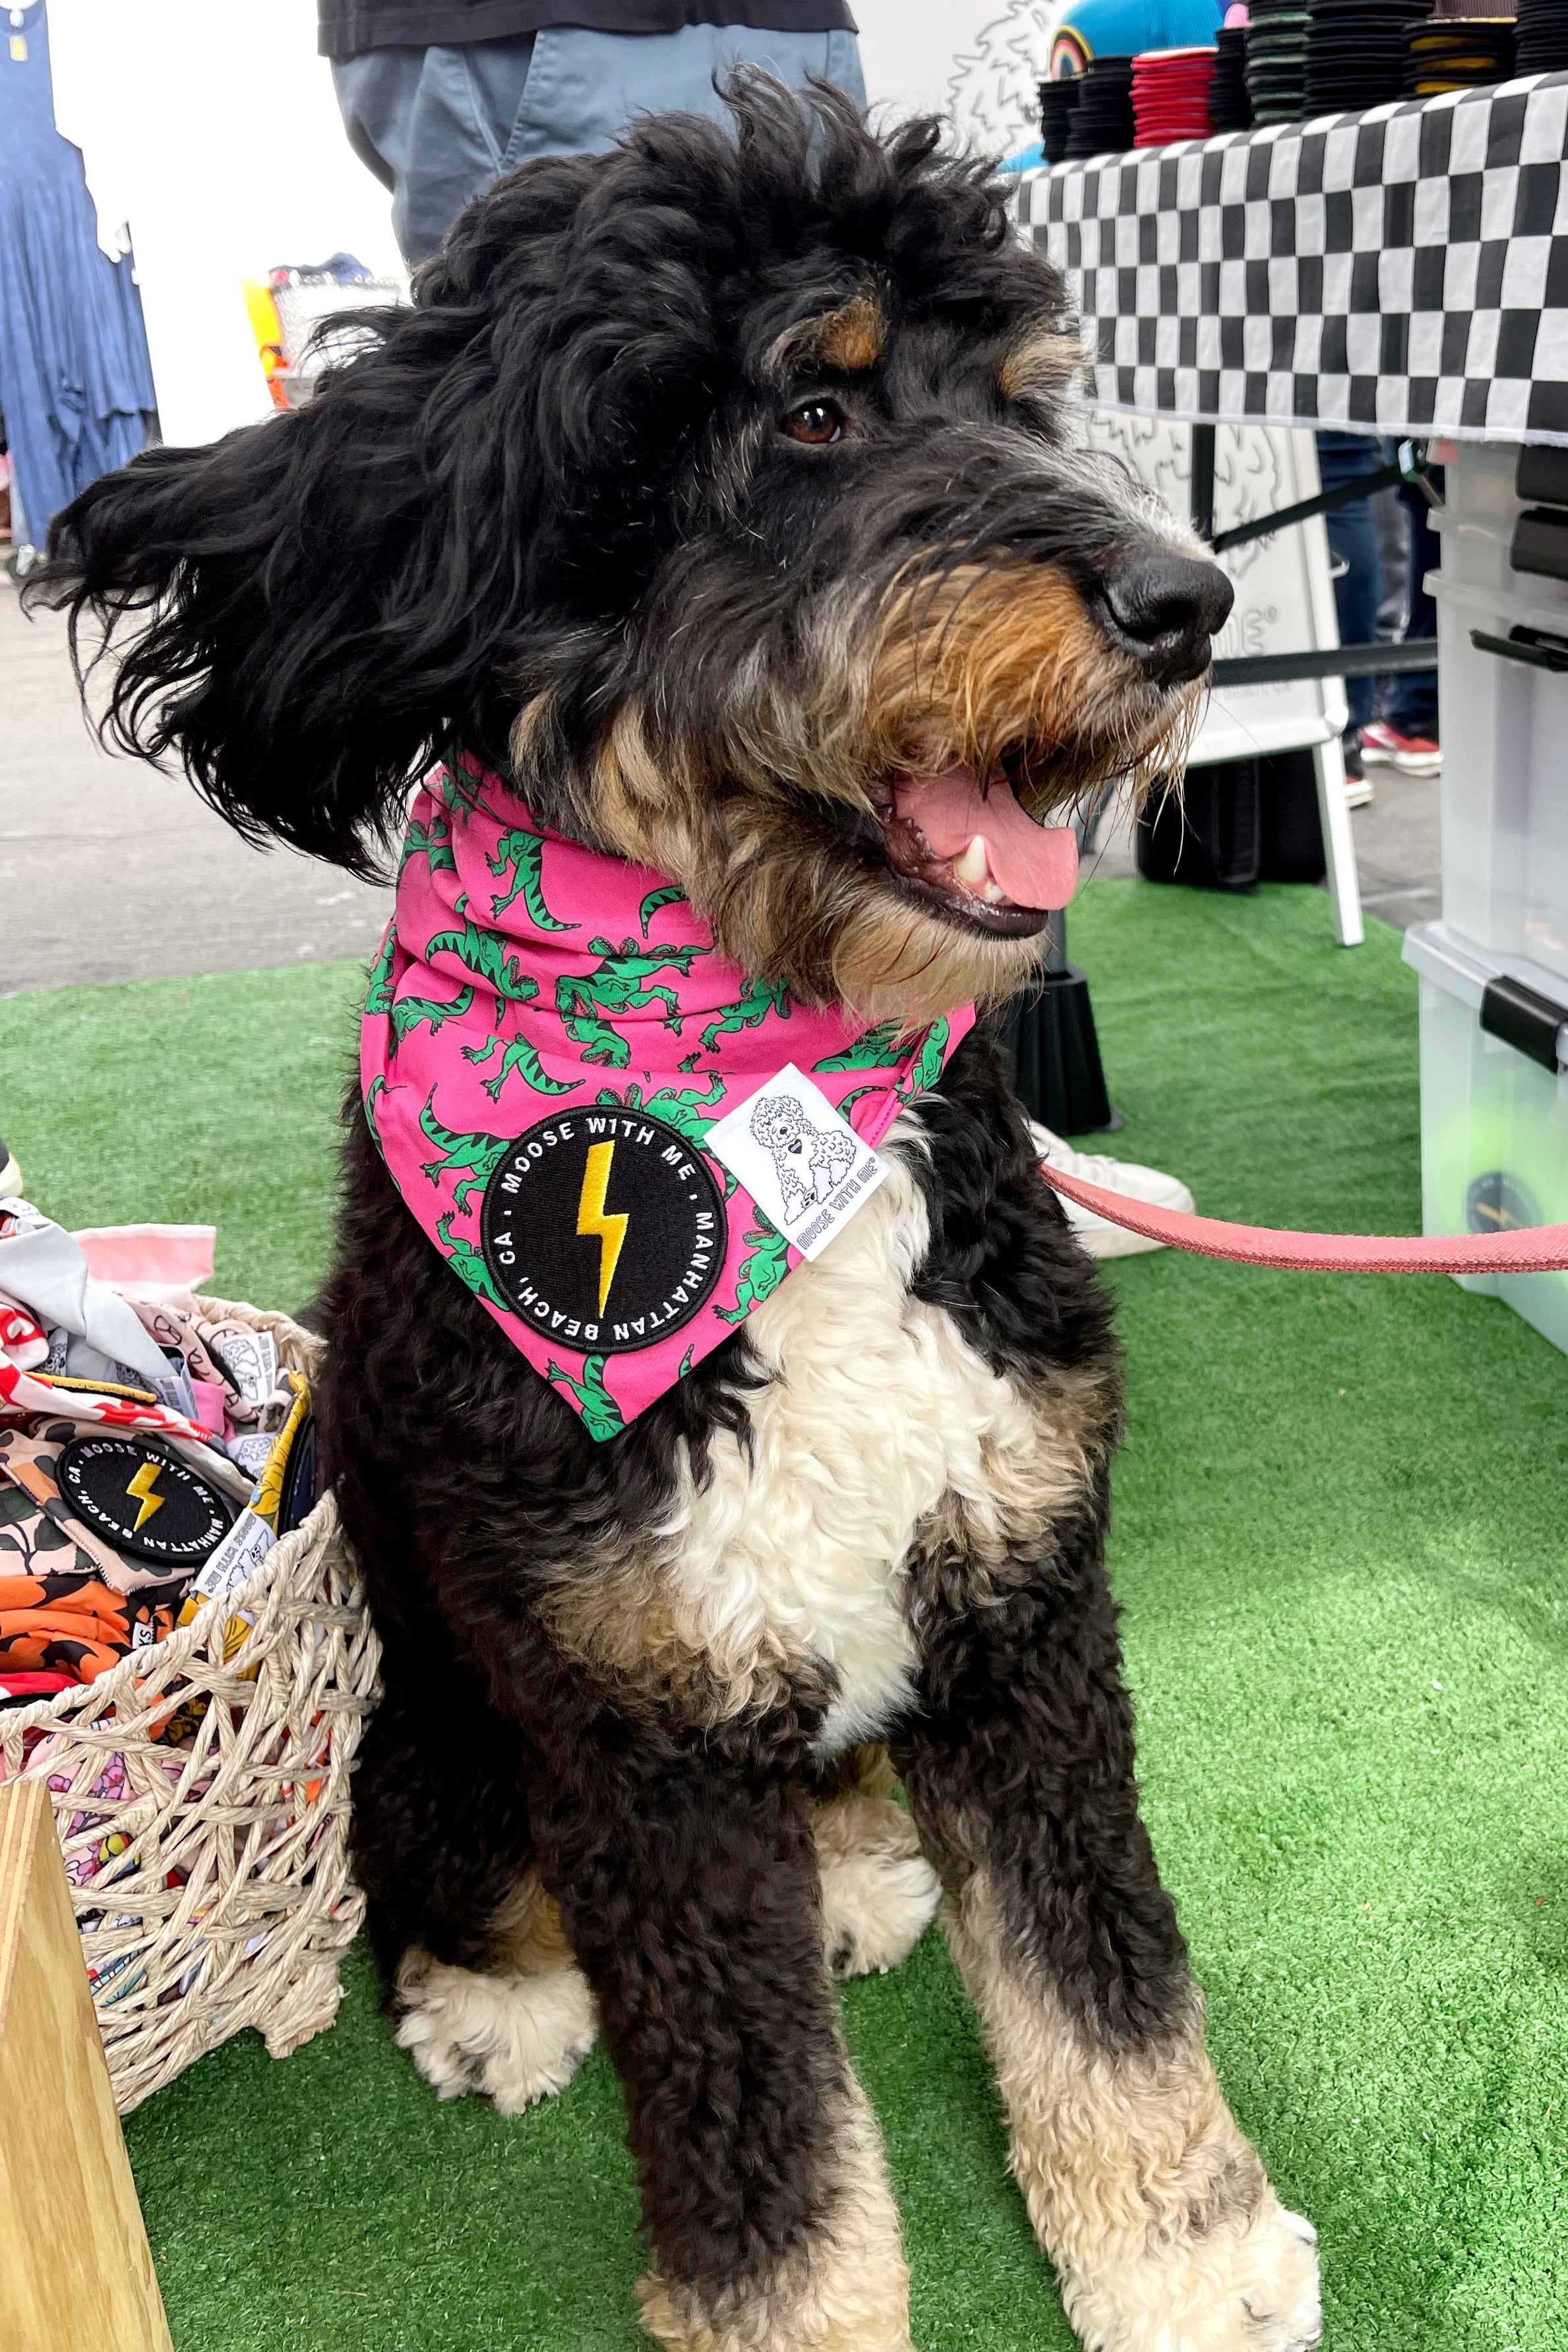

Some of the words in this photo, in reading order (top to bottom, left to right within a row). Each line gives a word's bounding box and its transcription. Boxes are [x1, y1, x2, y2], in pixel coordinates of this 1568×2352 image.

[501, 1122, 574, 1193] MOOSE
[586, 1118, 655, 1145] WITH
[662, 1145, 696, 1180] ME
[797, 1209, 835, 1250] MOOSE
[829, 1179, 861, 1211] WITH
[495, 1232, 516, 1264] CA
[614, 1212, 714, 1341] MANHATTAN
[69, 1466, 80, 1484] CA
[80, 1443, 137, 1458] MOOSE
[146, 1451, 191, 1481] WITH
[193, 1486, 215, 1504] ME
[143, 1518, 224, 1552] MANHATTAN
[216, 1546, 238, 1572] WITH
